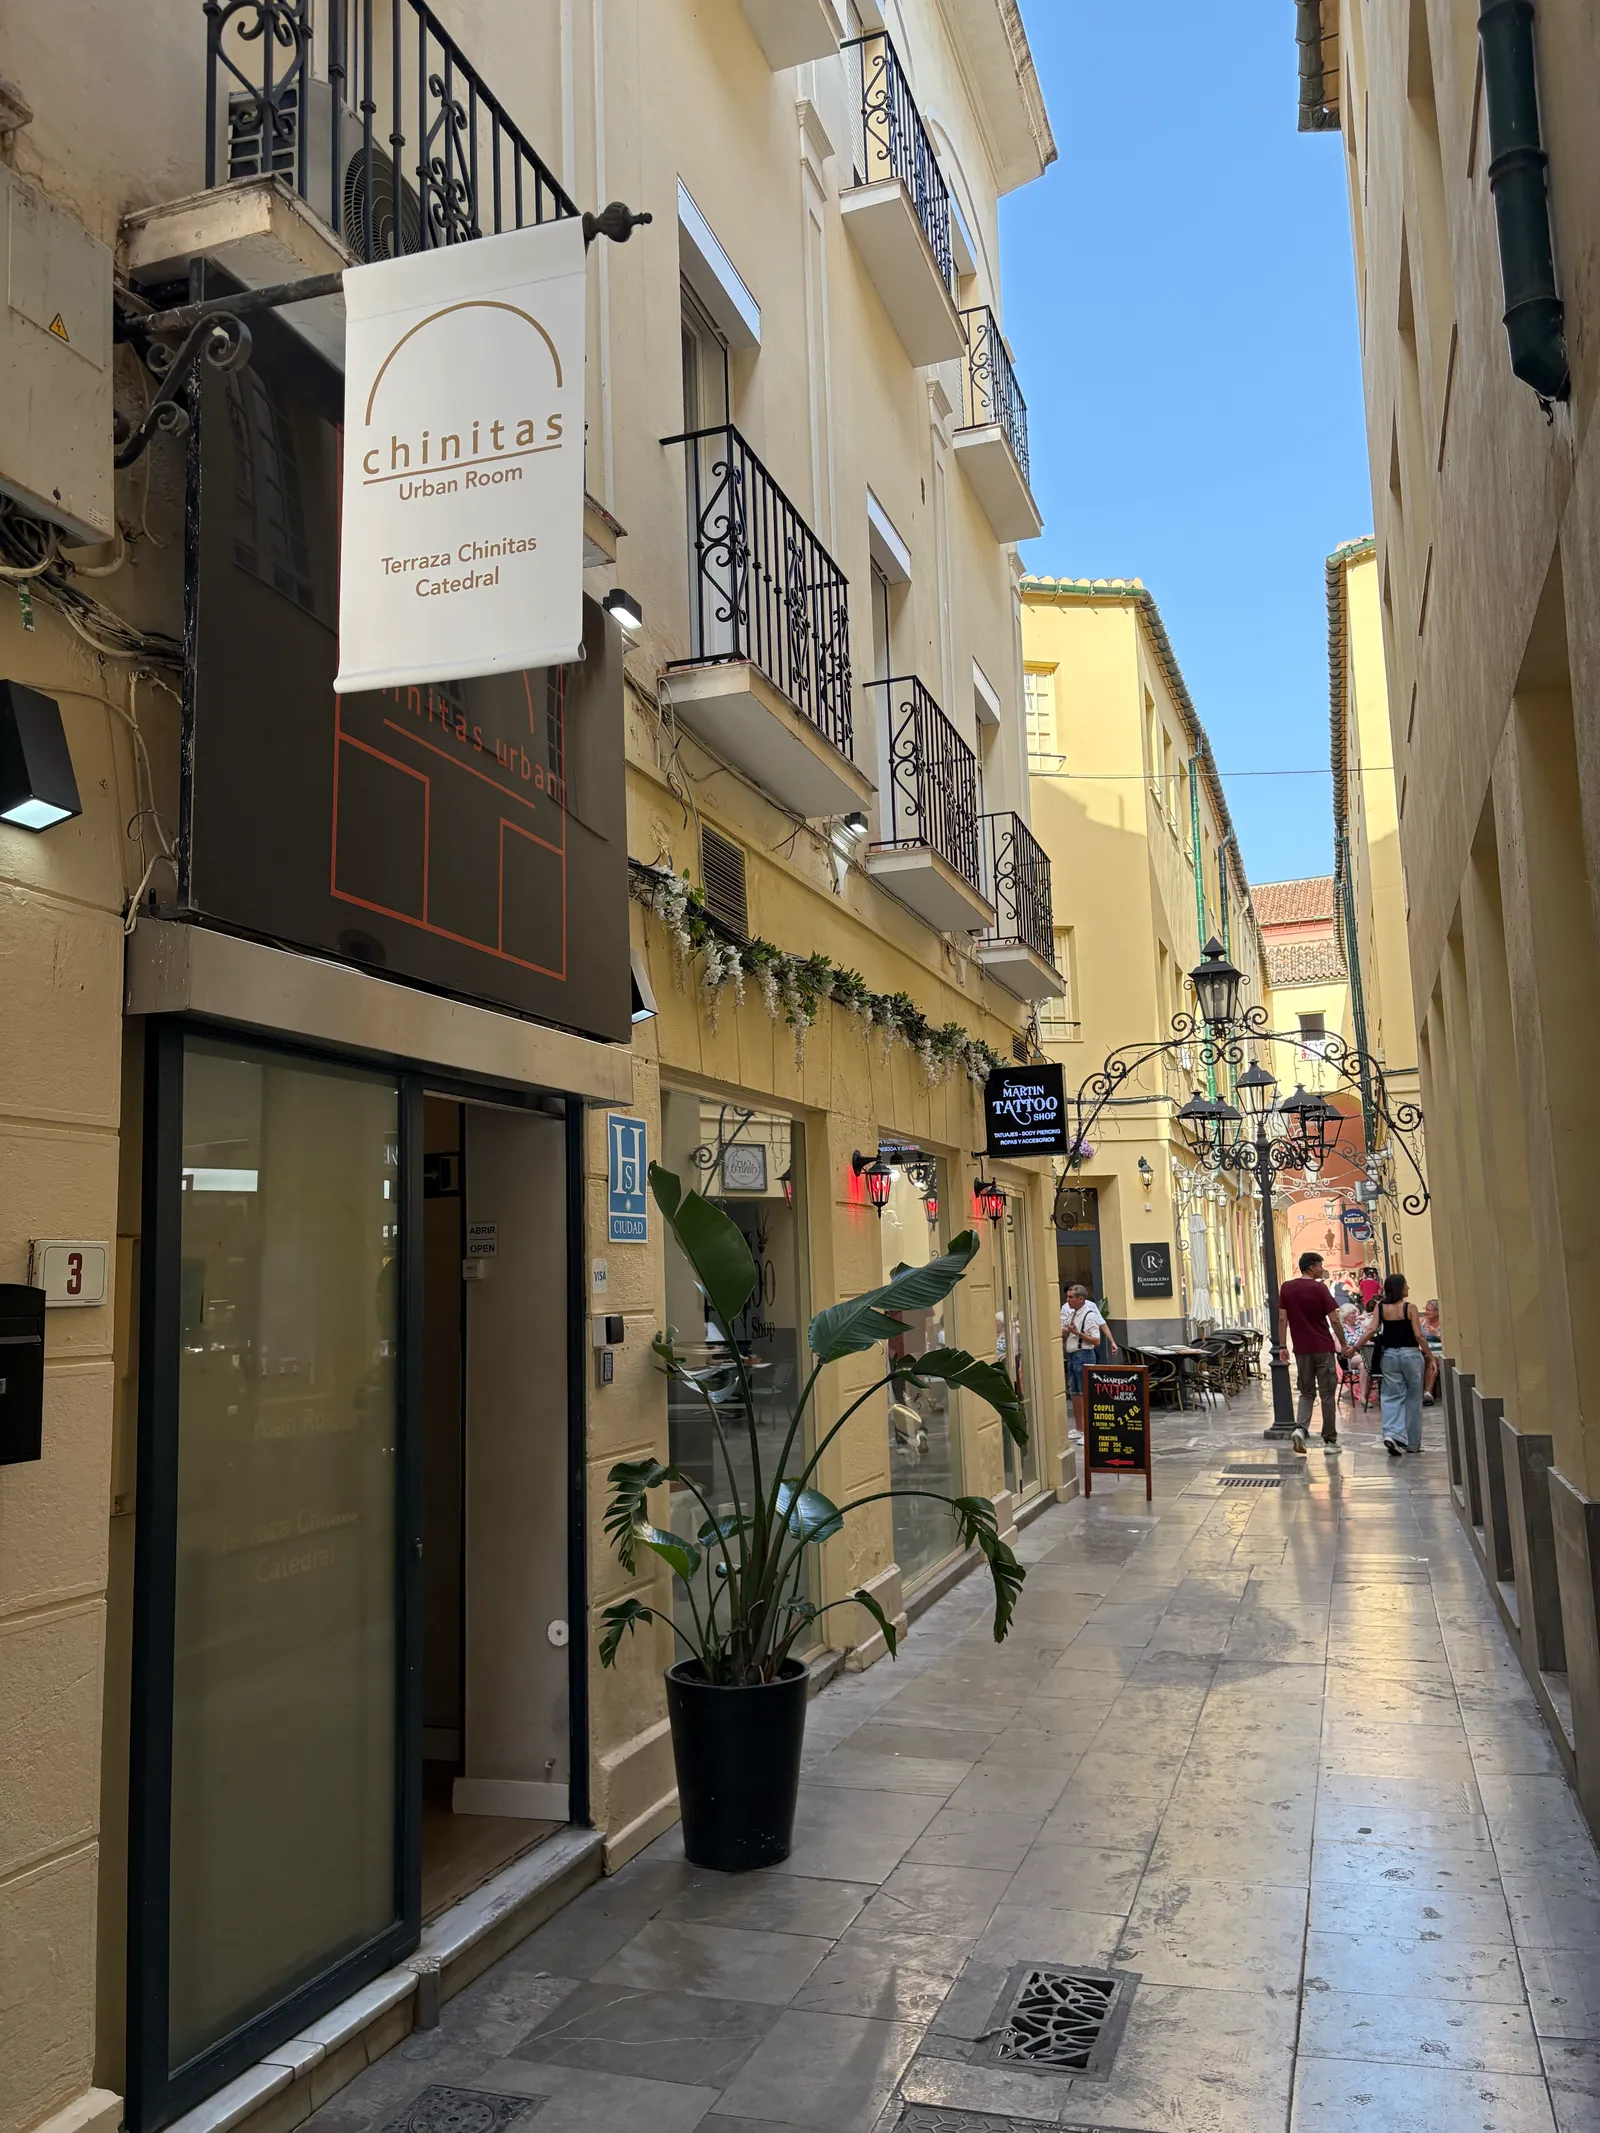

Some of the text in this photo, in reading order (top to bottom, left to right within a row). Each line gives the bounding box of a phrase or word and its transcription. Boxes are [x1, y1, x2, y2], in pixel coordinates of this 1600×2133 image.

[363, 413, 563, 476] chinitas
[399, 465, 523, 501] Urban Room
[381, 535, 537, 576] Terraza Chinitas
[415, 565, 500, 598] Catedral
[382, 684, 557, 799] nitas urban
[1003, 1084, 1044, 1098] MARTIN
[992, 1096, 1058, 1116] TATTOO
[1033, 1112, 1057, 1121] SHOP
[612, 1123, 644, 1196] H
[469, 1226, 496, 1235] ABRIR
[613, 1219, 644, 1235] CIUDAD
[470, 1243, 495, 1253] OPEN
[1147, 1255, 1158, 1268] R
[66, 1252, 83, 1295] 3
[594, 1270, 607, 1282] VISA
[752, 1316, 775, 1342] Shop
[1094, 1383, 1137, 1395] TATTOO
[1093, 1404, 1115, 1412] COUPLE
[1093, 1412, 1115, 1420] TATTOOS
[1117, 1417, 1124, 1426] 2
